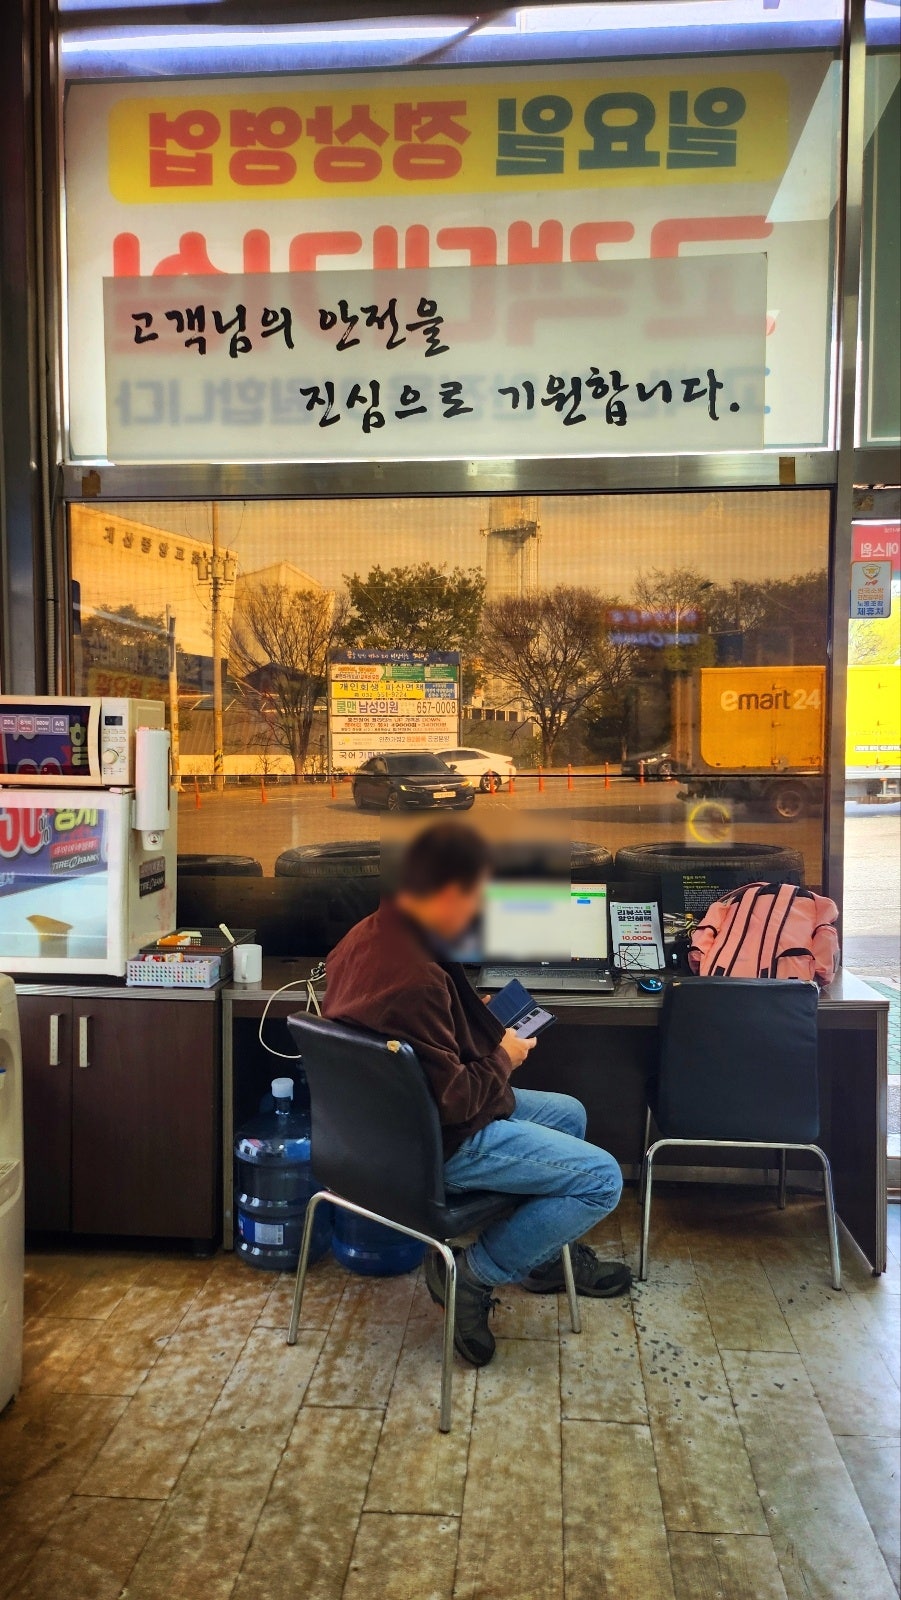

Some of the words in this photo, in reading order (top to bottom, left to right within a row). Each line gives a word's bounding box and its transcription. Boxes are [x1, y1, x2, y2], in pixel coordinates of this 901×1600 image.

[131, 304, 295, 358] 고객님의
[318, 297, 450, 357] 안전을
[300, 380, 473, 433] 진심으로
[498, 366, 740, 426] 기원합니다.
[857, 607, 884, 616] 제휴처
[336, 700, 357, 714] 쿨맨
[359, 701, 399, 715] 남성의원
[417, 701, 456, 714] 657-0008
[339, 752, 356, 760] 국어
